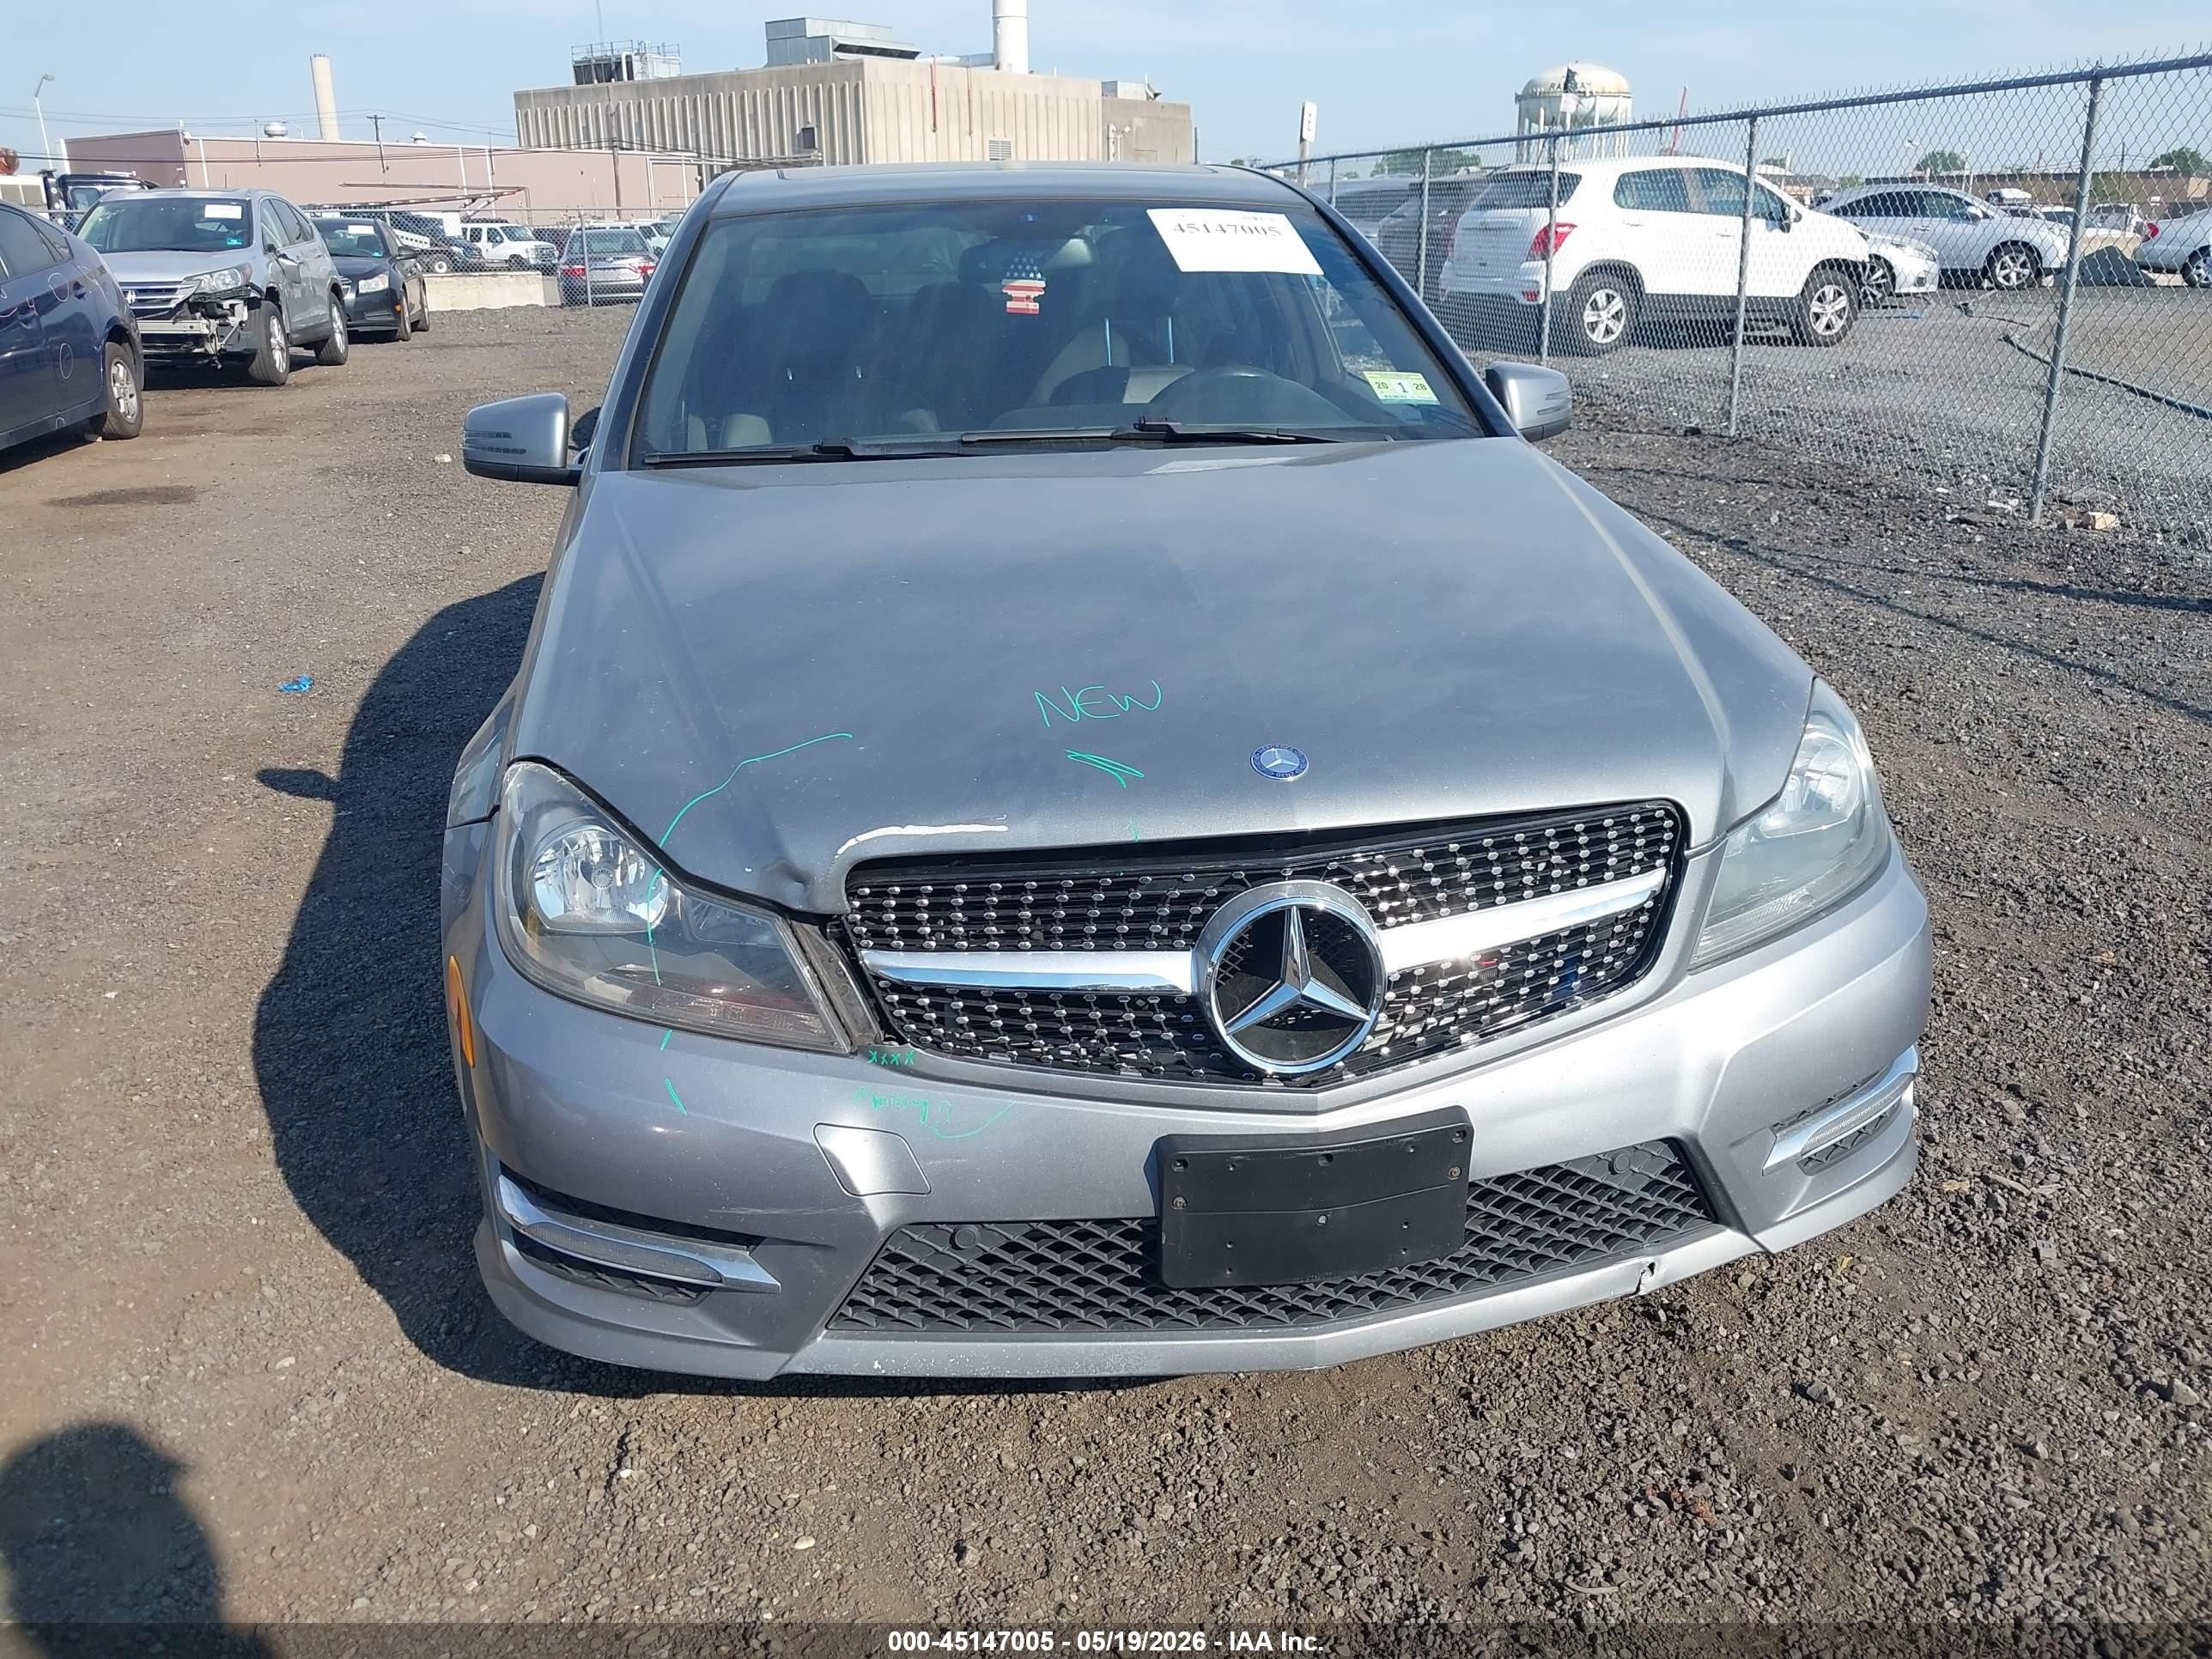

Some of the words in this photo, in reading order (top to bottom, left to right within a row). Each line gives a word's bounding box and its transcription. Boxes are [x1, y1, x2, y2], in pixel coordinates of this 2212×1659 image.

[1548, 82, 1593, 91] RAAY
[1173, 222, 1281, 236] 45147005
[1397, 382, 1408, 393] 1
[1034, 679, 1162, 727] NEW
